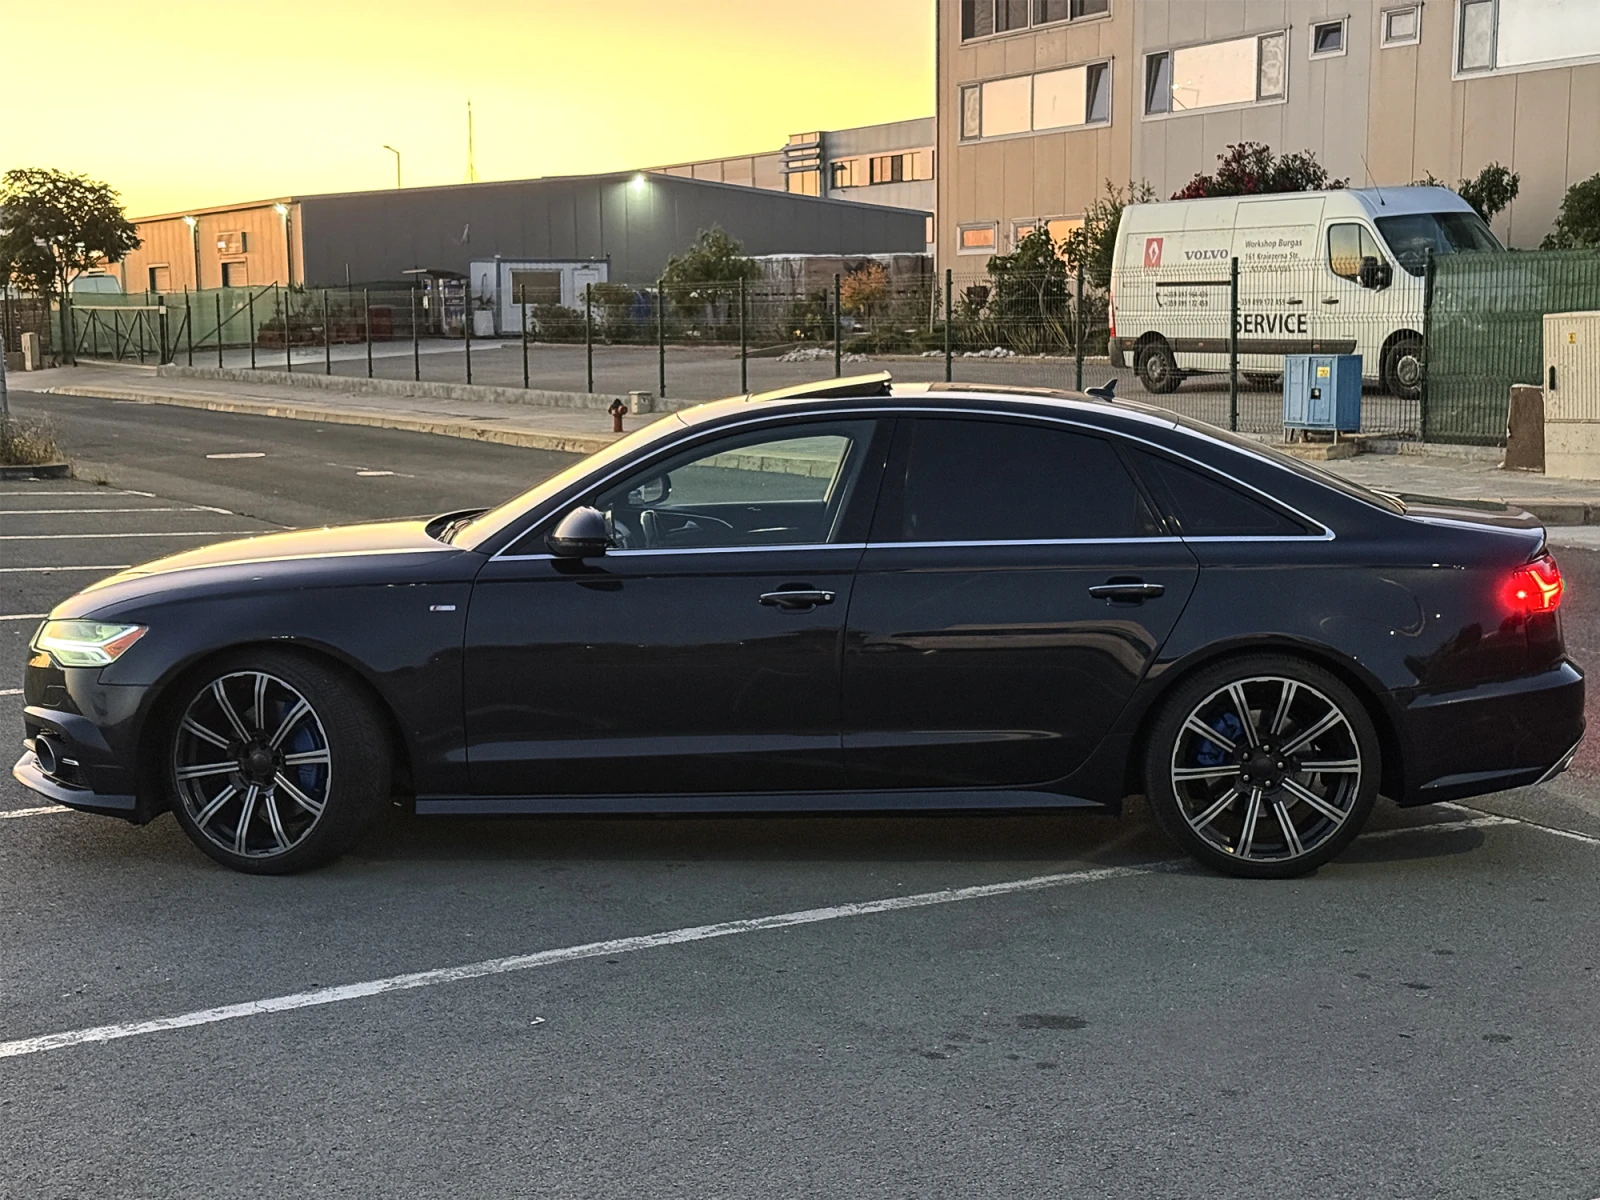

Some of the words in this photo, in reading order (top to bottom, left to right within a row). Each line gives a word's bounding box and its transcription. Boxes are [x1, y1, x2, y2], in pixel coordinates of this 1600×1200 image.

[1245, 240, 1276, 249] Workshop
[1278, 239, 1302, 248] Burgas
[1184, 249, 1229, 260] VOLVO
[1236, 313, 1307, 334] SERVICE
